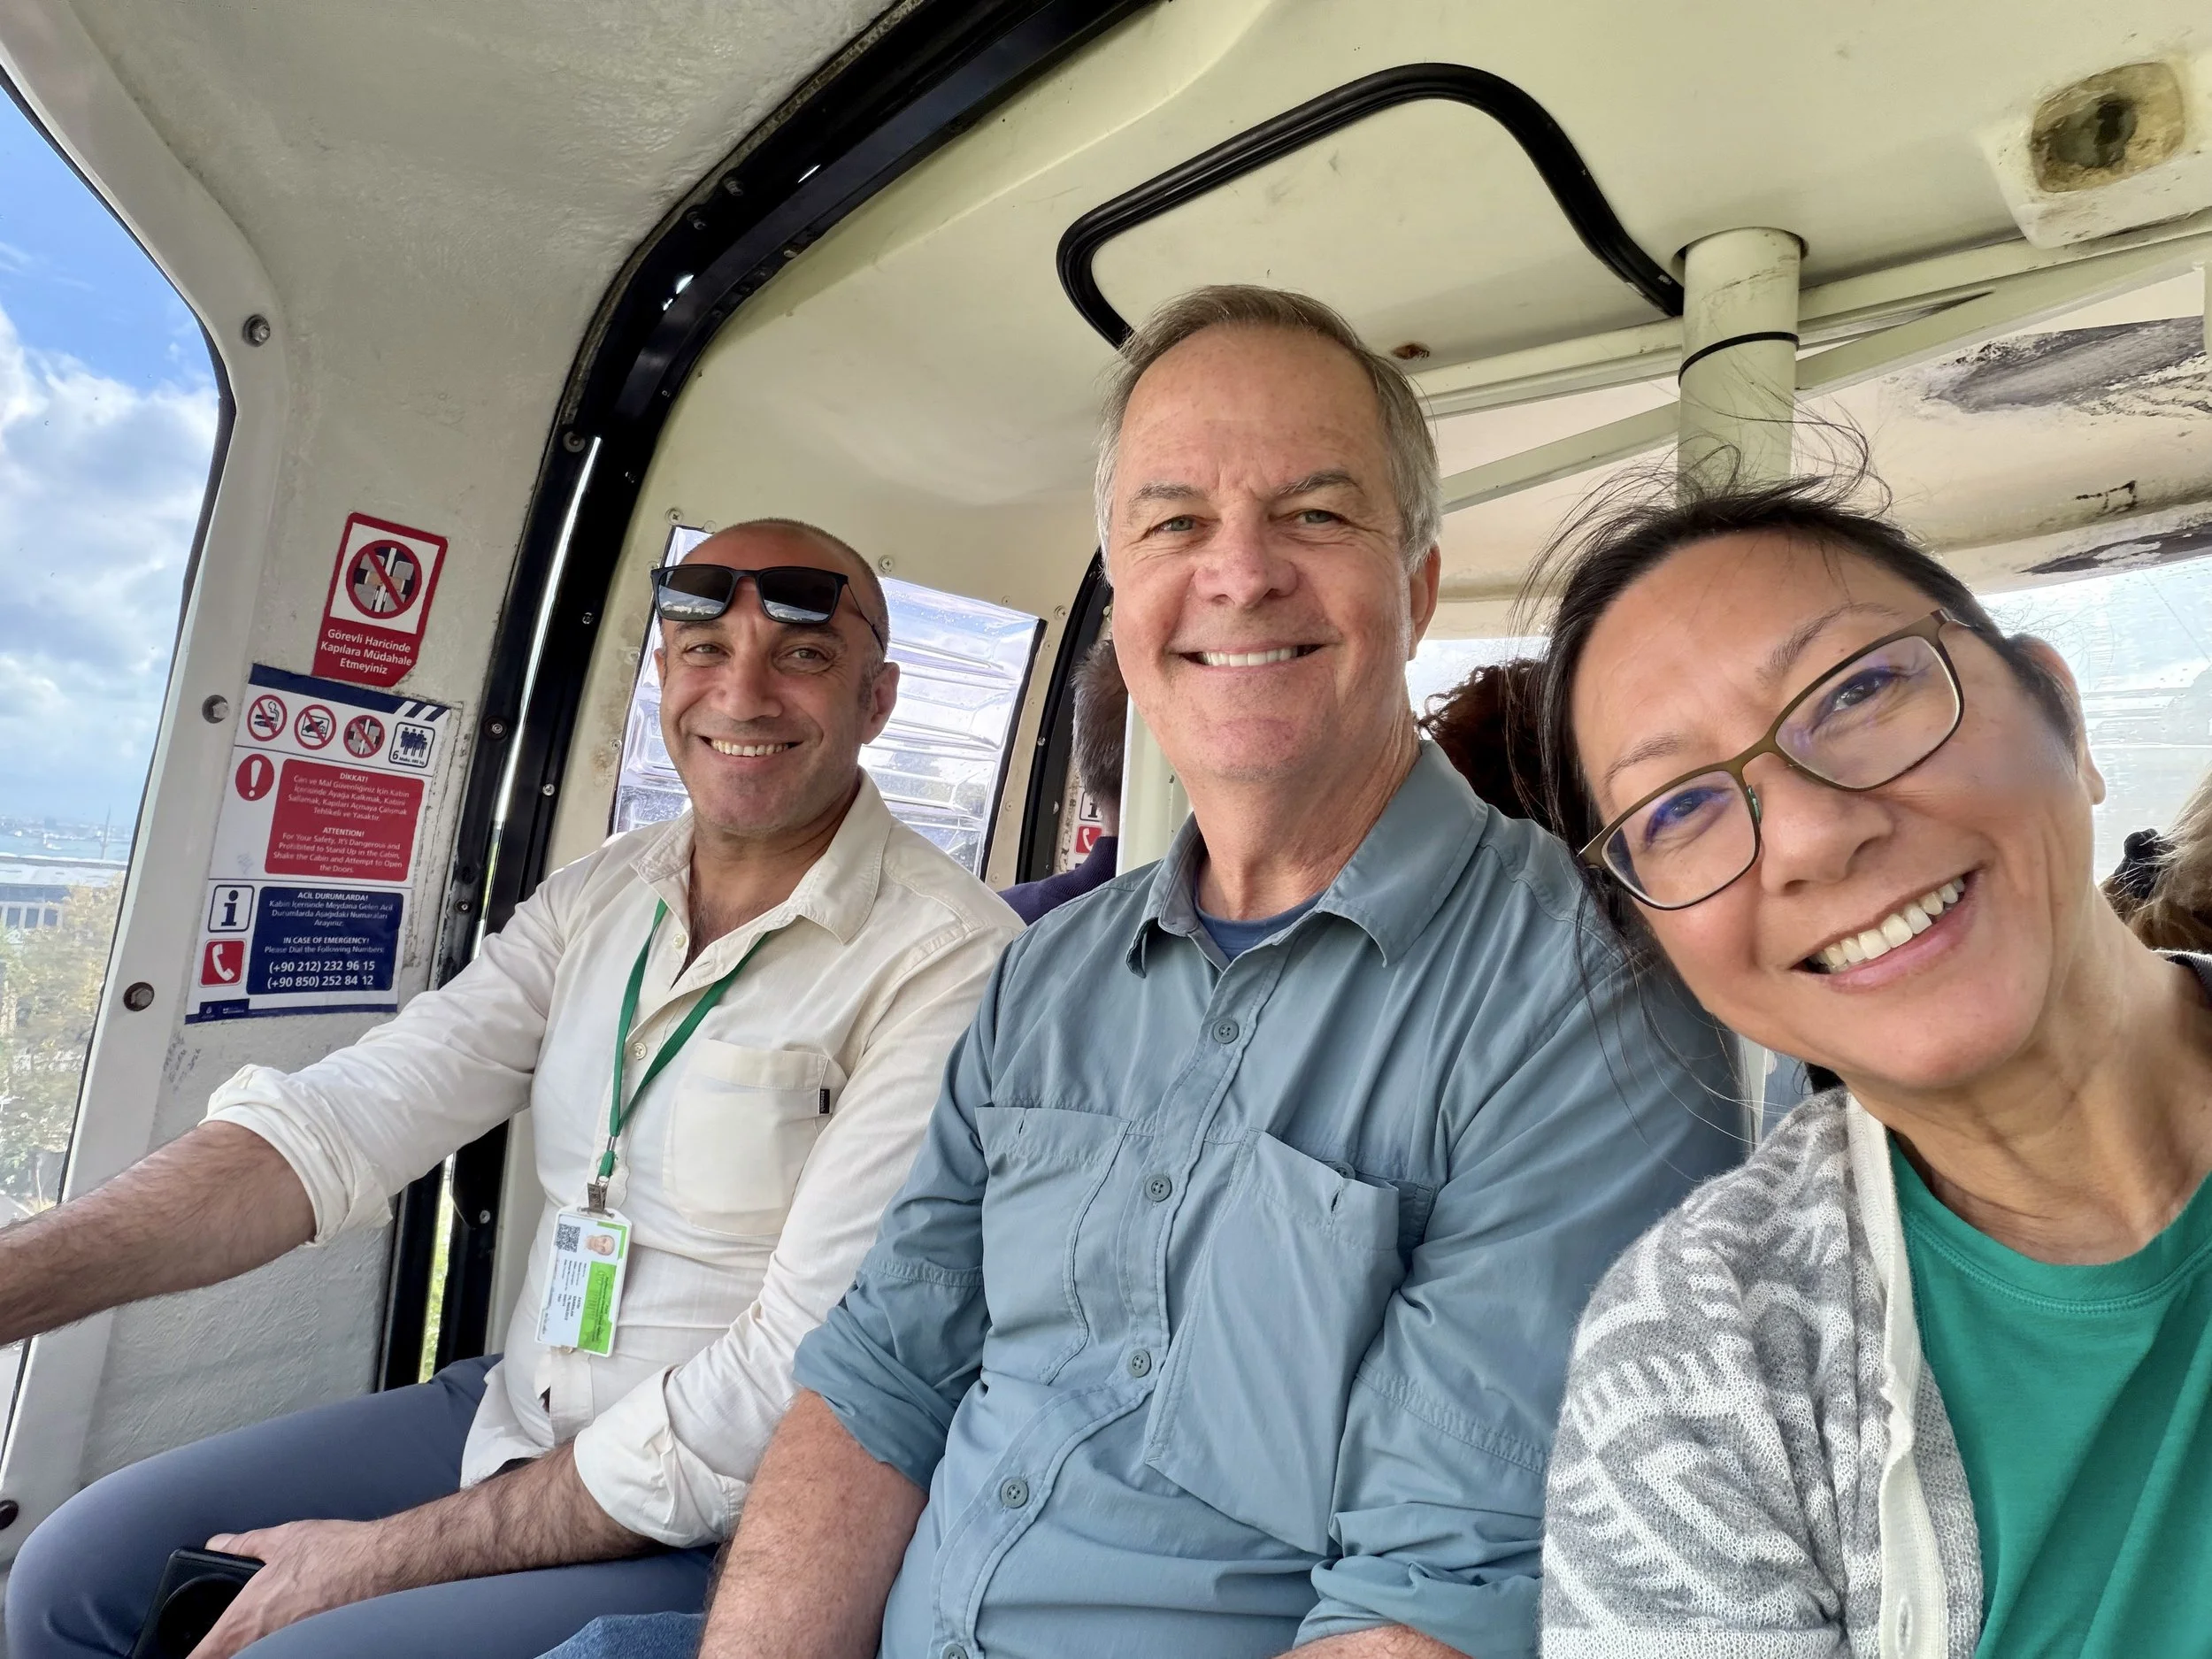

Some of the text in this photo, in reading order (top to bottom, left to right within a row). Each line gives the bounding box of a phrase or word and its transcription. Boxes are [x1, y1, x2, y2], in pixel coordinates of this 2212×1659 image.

[327, 629, 411, 653] Görevli Haricinde
[320, 641, 412, 666] Kapılara Müdahale
[340, 657, 388, 674] Etmeyiniz
[392, 750, 399, 760] 6
[294, 775, 307, 784] Can
[340, 772, 368, 783] DİKKAT!
[322, 826, 365, 837] ATTENTION!
[279, 842, 315, 851] Prohibited
[326, 845, 345, 854] Stand
[349, 839, 386, 850] Dangerous
[273, 851, 294, 860] Shake
[344, 856, 373, 866] Attempt
[315, 893, 369, 902] DURUMLARDA!
[326, 902, 357, 910] Meydana
[272, 909, 314, 918] Durumlarda
[269, 960, 375, 974] (+90 212) 232 96 15
[267, 974, 373, 989] (+90 850) 252 84 12
